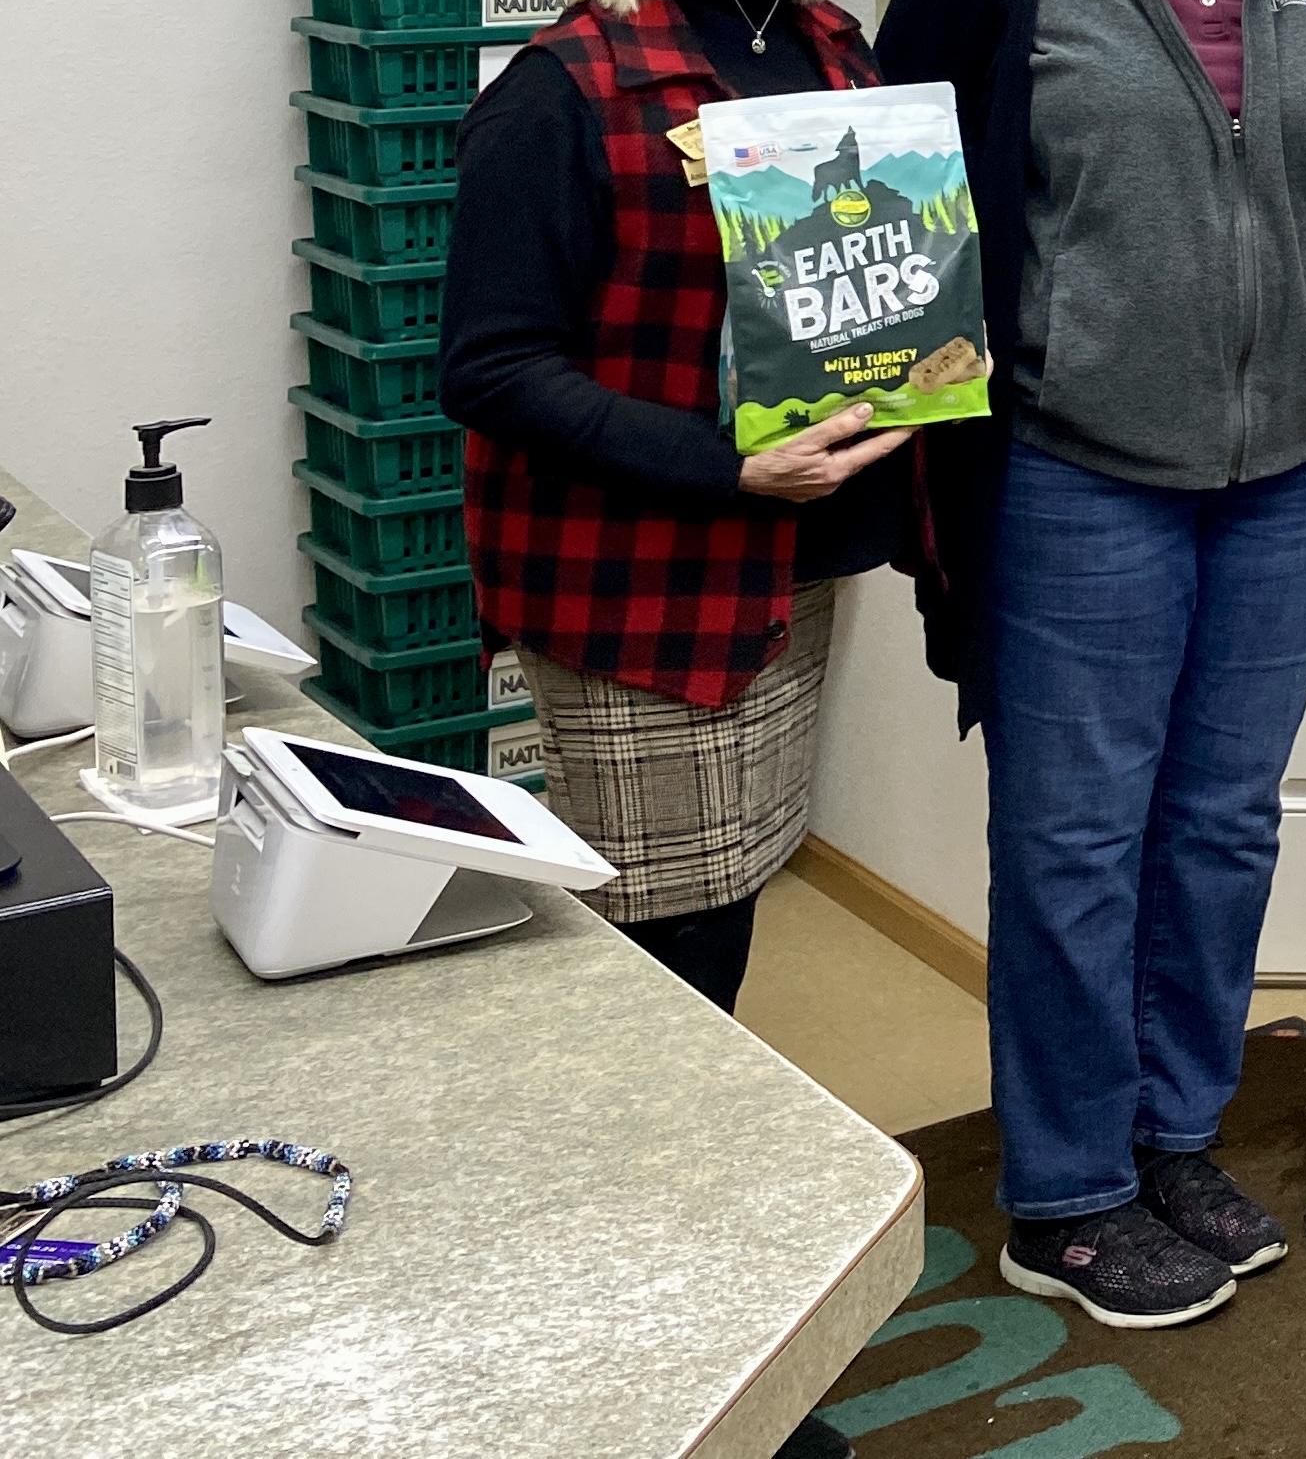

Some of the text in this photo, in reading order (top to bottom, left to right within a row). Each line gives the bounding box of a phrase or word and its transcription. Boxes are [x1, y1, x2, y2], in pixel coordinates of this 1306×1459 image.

[759, 147, 778, 157] USA
[794, 220, 914, 284] EARTH
[783, 253, 940, 341] BARS
[810, 306, 925, 350] NATURAL TREATS FOR DOGS
[865, 348, 918, 368] TURKEY
